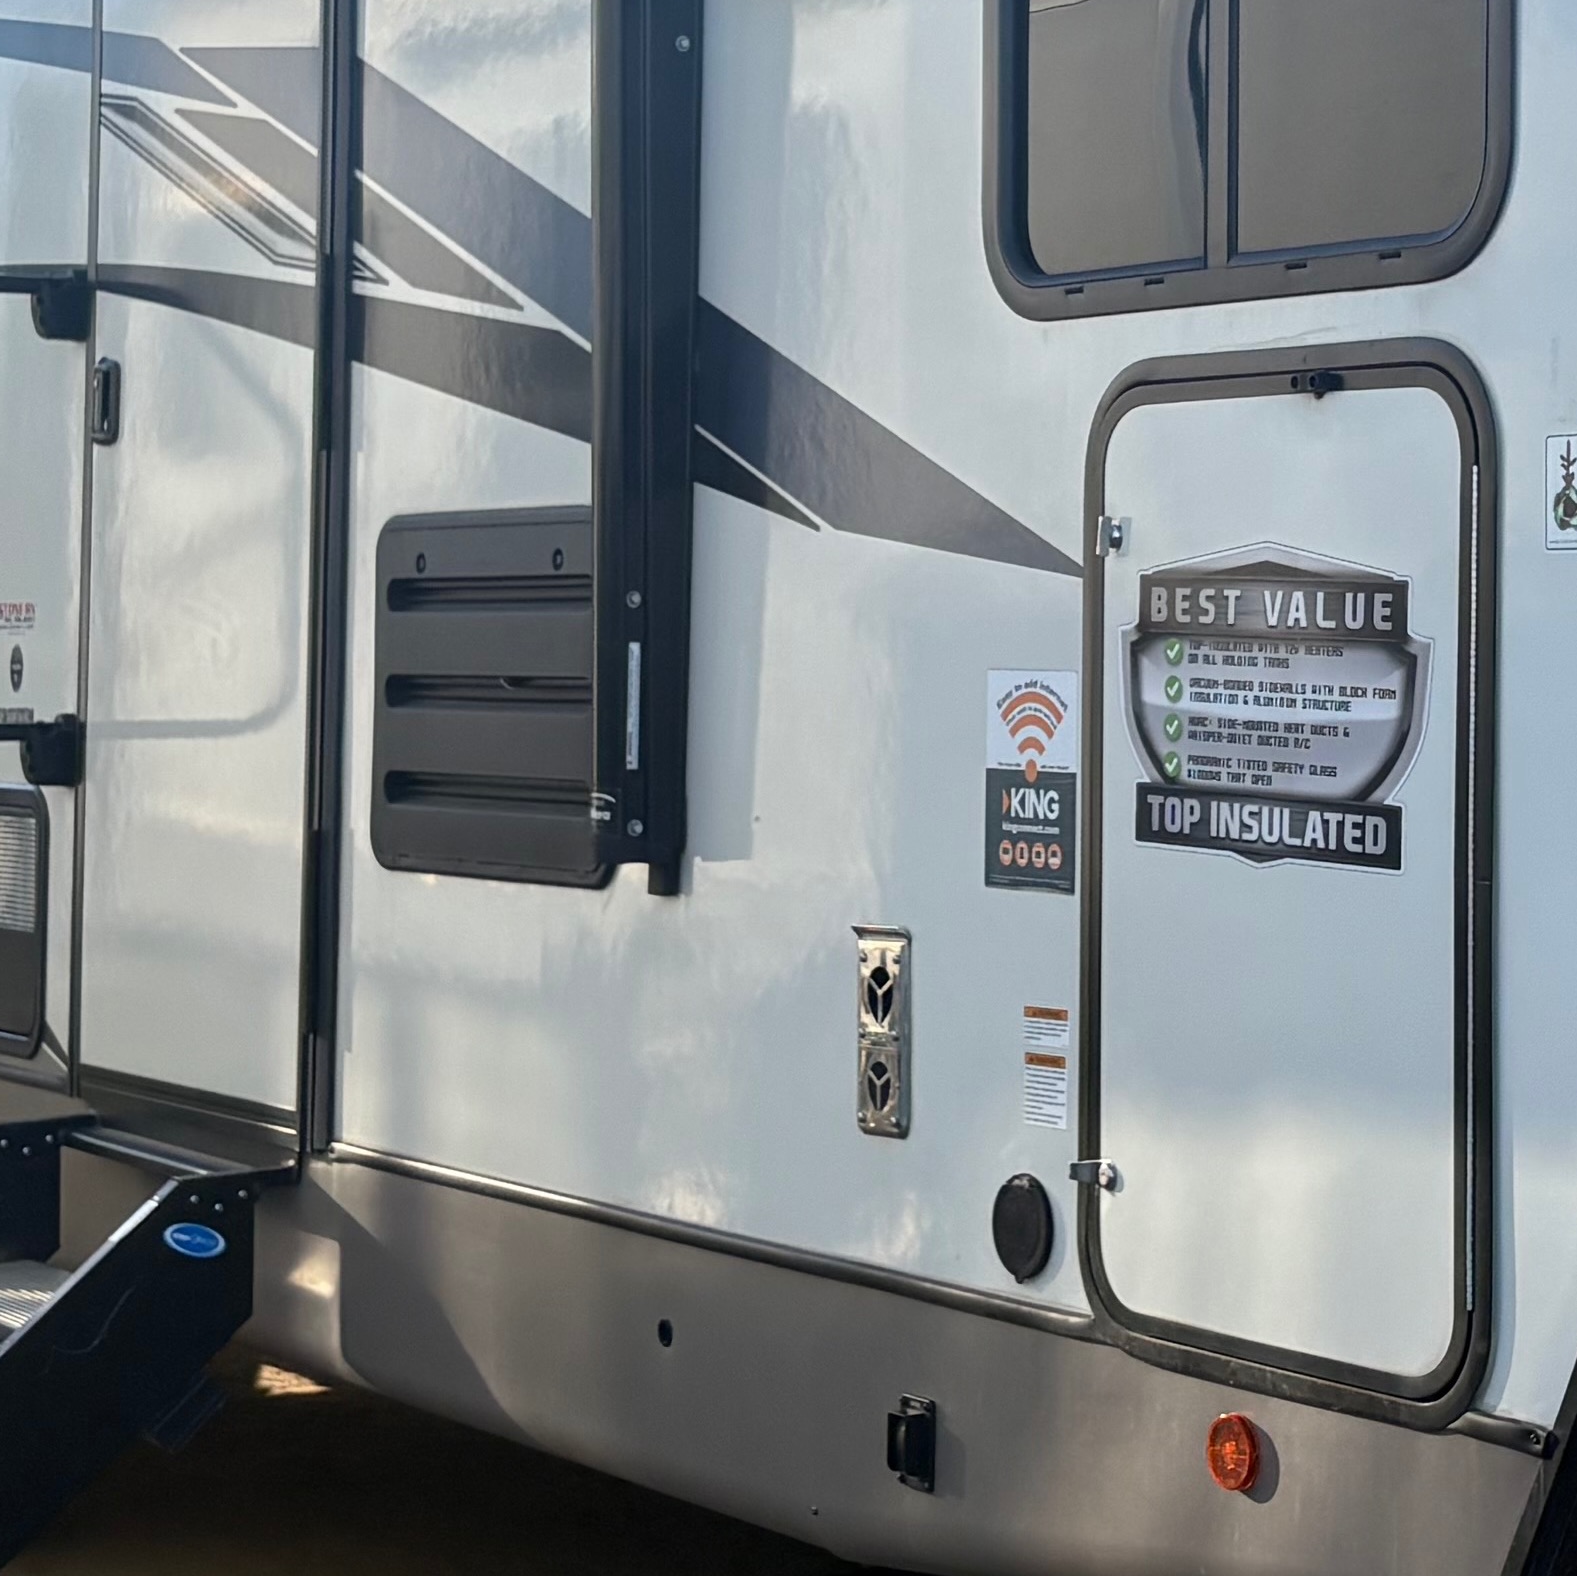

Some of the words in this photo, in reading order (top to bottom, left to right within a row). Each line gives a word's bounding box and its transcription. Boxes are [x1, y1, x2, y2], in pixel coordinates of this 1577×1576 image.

[1150, 586, 1241, 626] BEST
[1263, 590, 1394, 632] VALUE
[1010, 787, 1060, 821] KING
[1147, 794, 1201, 834] TOP
[1210, 801, 1387, 856] INSULATED
